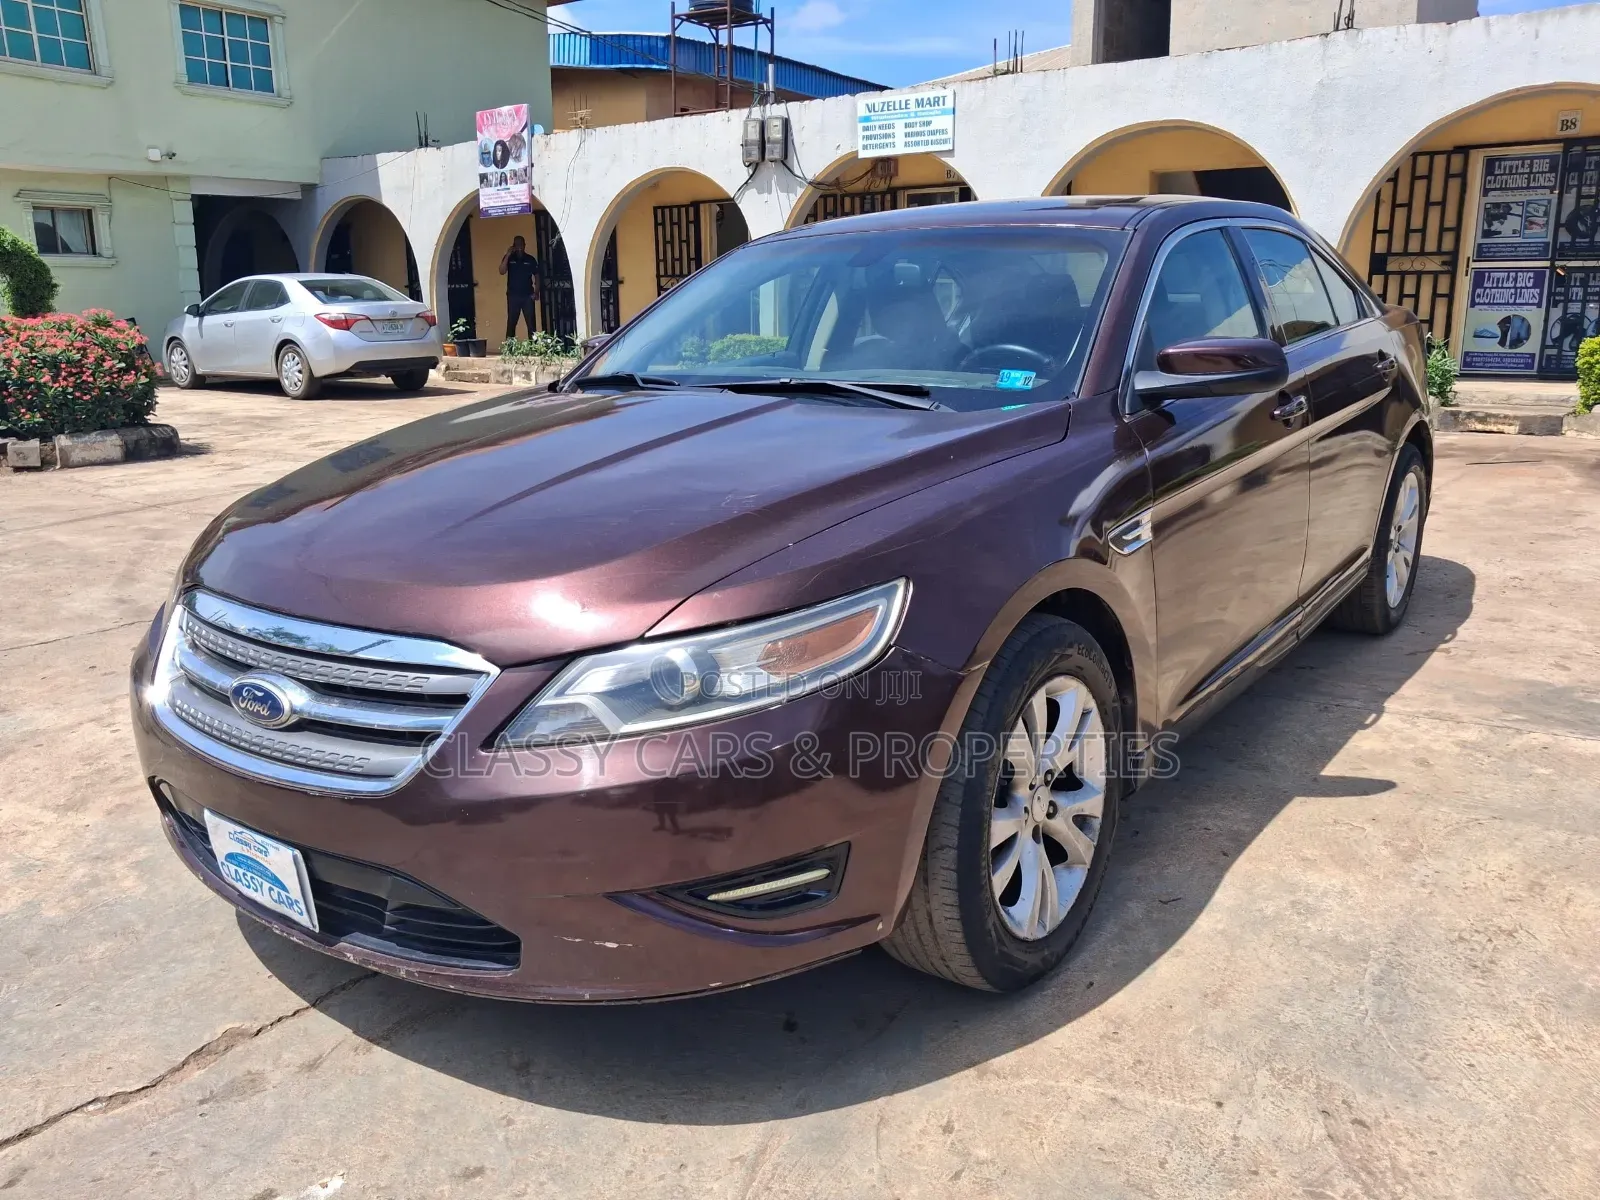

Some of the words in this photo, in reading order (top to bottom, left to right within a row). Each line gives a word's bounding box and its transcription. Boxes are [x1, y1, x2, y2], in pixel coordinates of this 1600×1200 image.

[865, 99, 911, 113] NUZELLE
[914, 95, 947, 109] MART
[862, 124, 877, 132] DAILY
[878, 123, 896, 131] NEEDS
[904, 121, 918, 129] BODY
[919, 120, 933, 128] SHOP
[1559, 117, 1577, 131] B8
[862, 132, 896, 141] PROVISIONS
[904, 130, 926, 138] VARIOUS
[927, 128, 948, 137] DIAPERS
[862, 142, 896, 150] DETERGENTS
[904, 139, 930, 148] ASSORTED
[930, 138, 951, 146] BISCUIT
[1494, 160, 1530, 174] LITTLE
[1532, 159, 1550, 172] BIG
[1485, 174, 1528, 188] CLOTHING
[1529, 173, 1556, 187] LINES
[1483, 272, 1516, 287] LITTLE
[1516, 272, 1534, 287] BIG
[1475, 288, 1516, 303] CLOTHING
[1516, 289, 1540, 303] LINES
[239, 686, 271, 720] Ford
[220, 861, 265, 897] CLASSY
[268, 885, 304, 917] CARS
